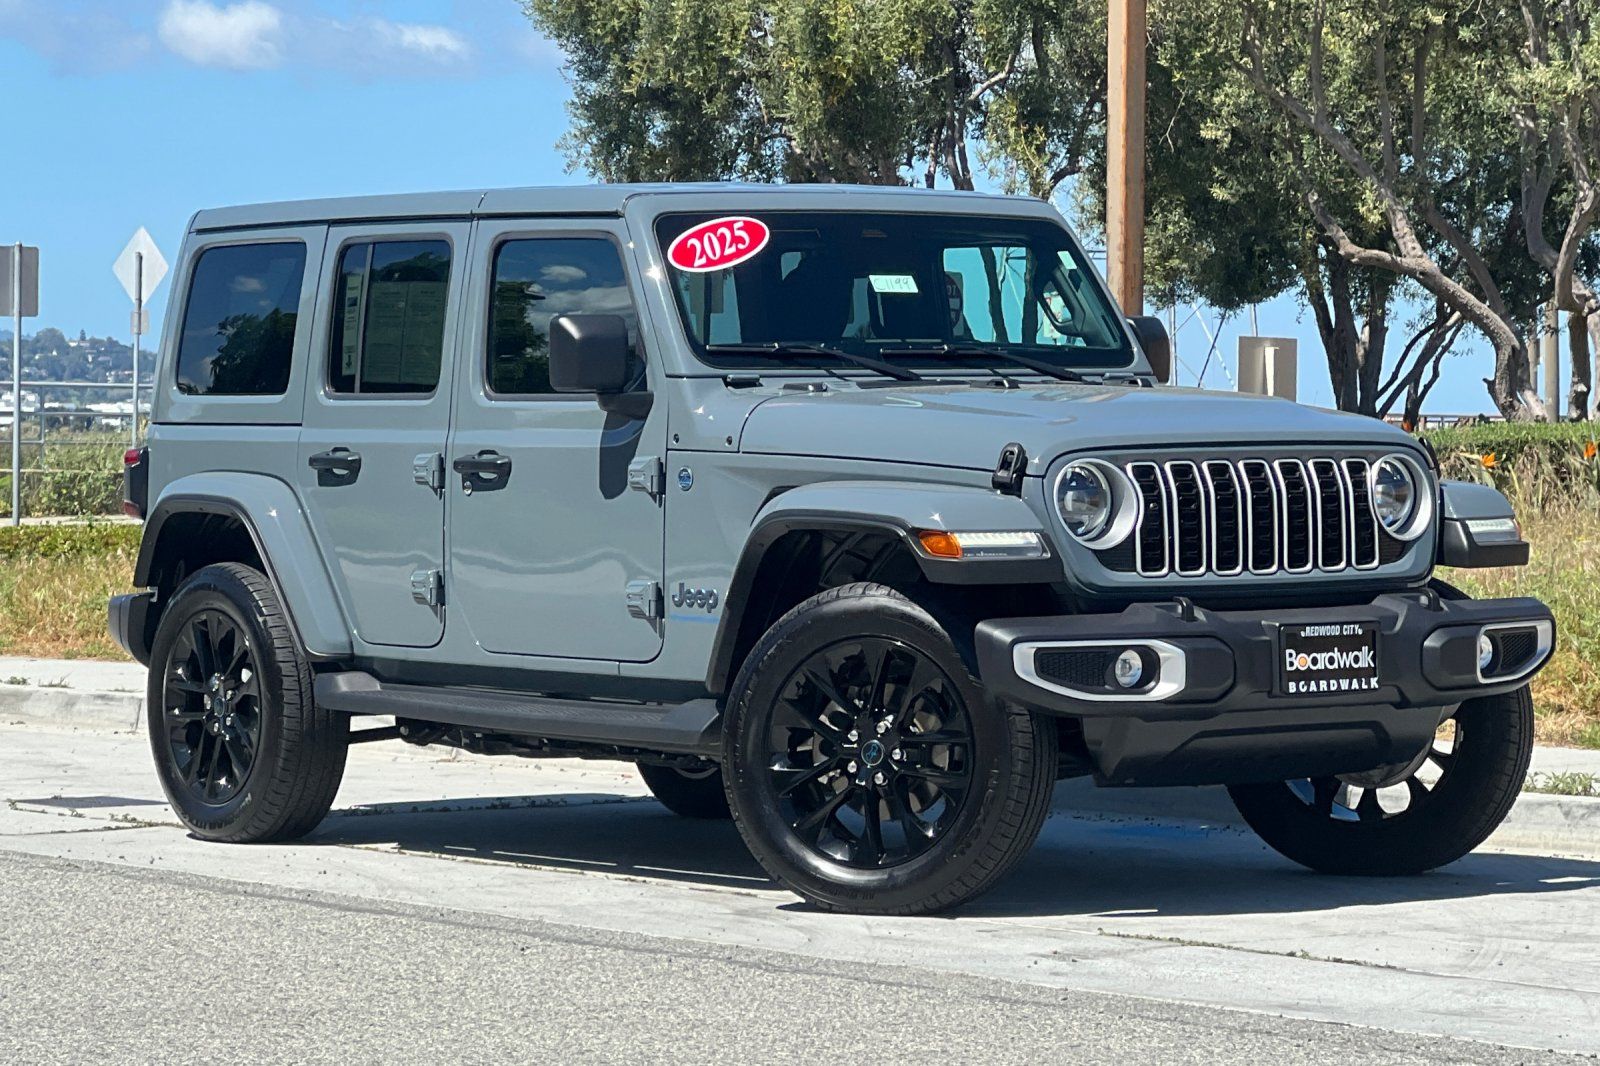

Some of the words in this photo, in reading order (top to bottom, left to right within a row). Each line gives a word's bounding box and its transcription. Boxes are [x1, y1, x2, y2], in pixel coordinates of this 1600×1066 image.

[687, 221, 750, 267] 2025
[672, 582, 718, 613] Jeep
[1305, 625, 1340, 637] REDWOOD
[1343, 624, 1359, 635] CITY
[1285, 646, 1374, 671] Boardwalk
[1288, 677, 1379, 693] BOARDWALK
